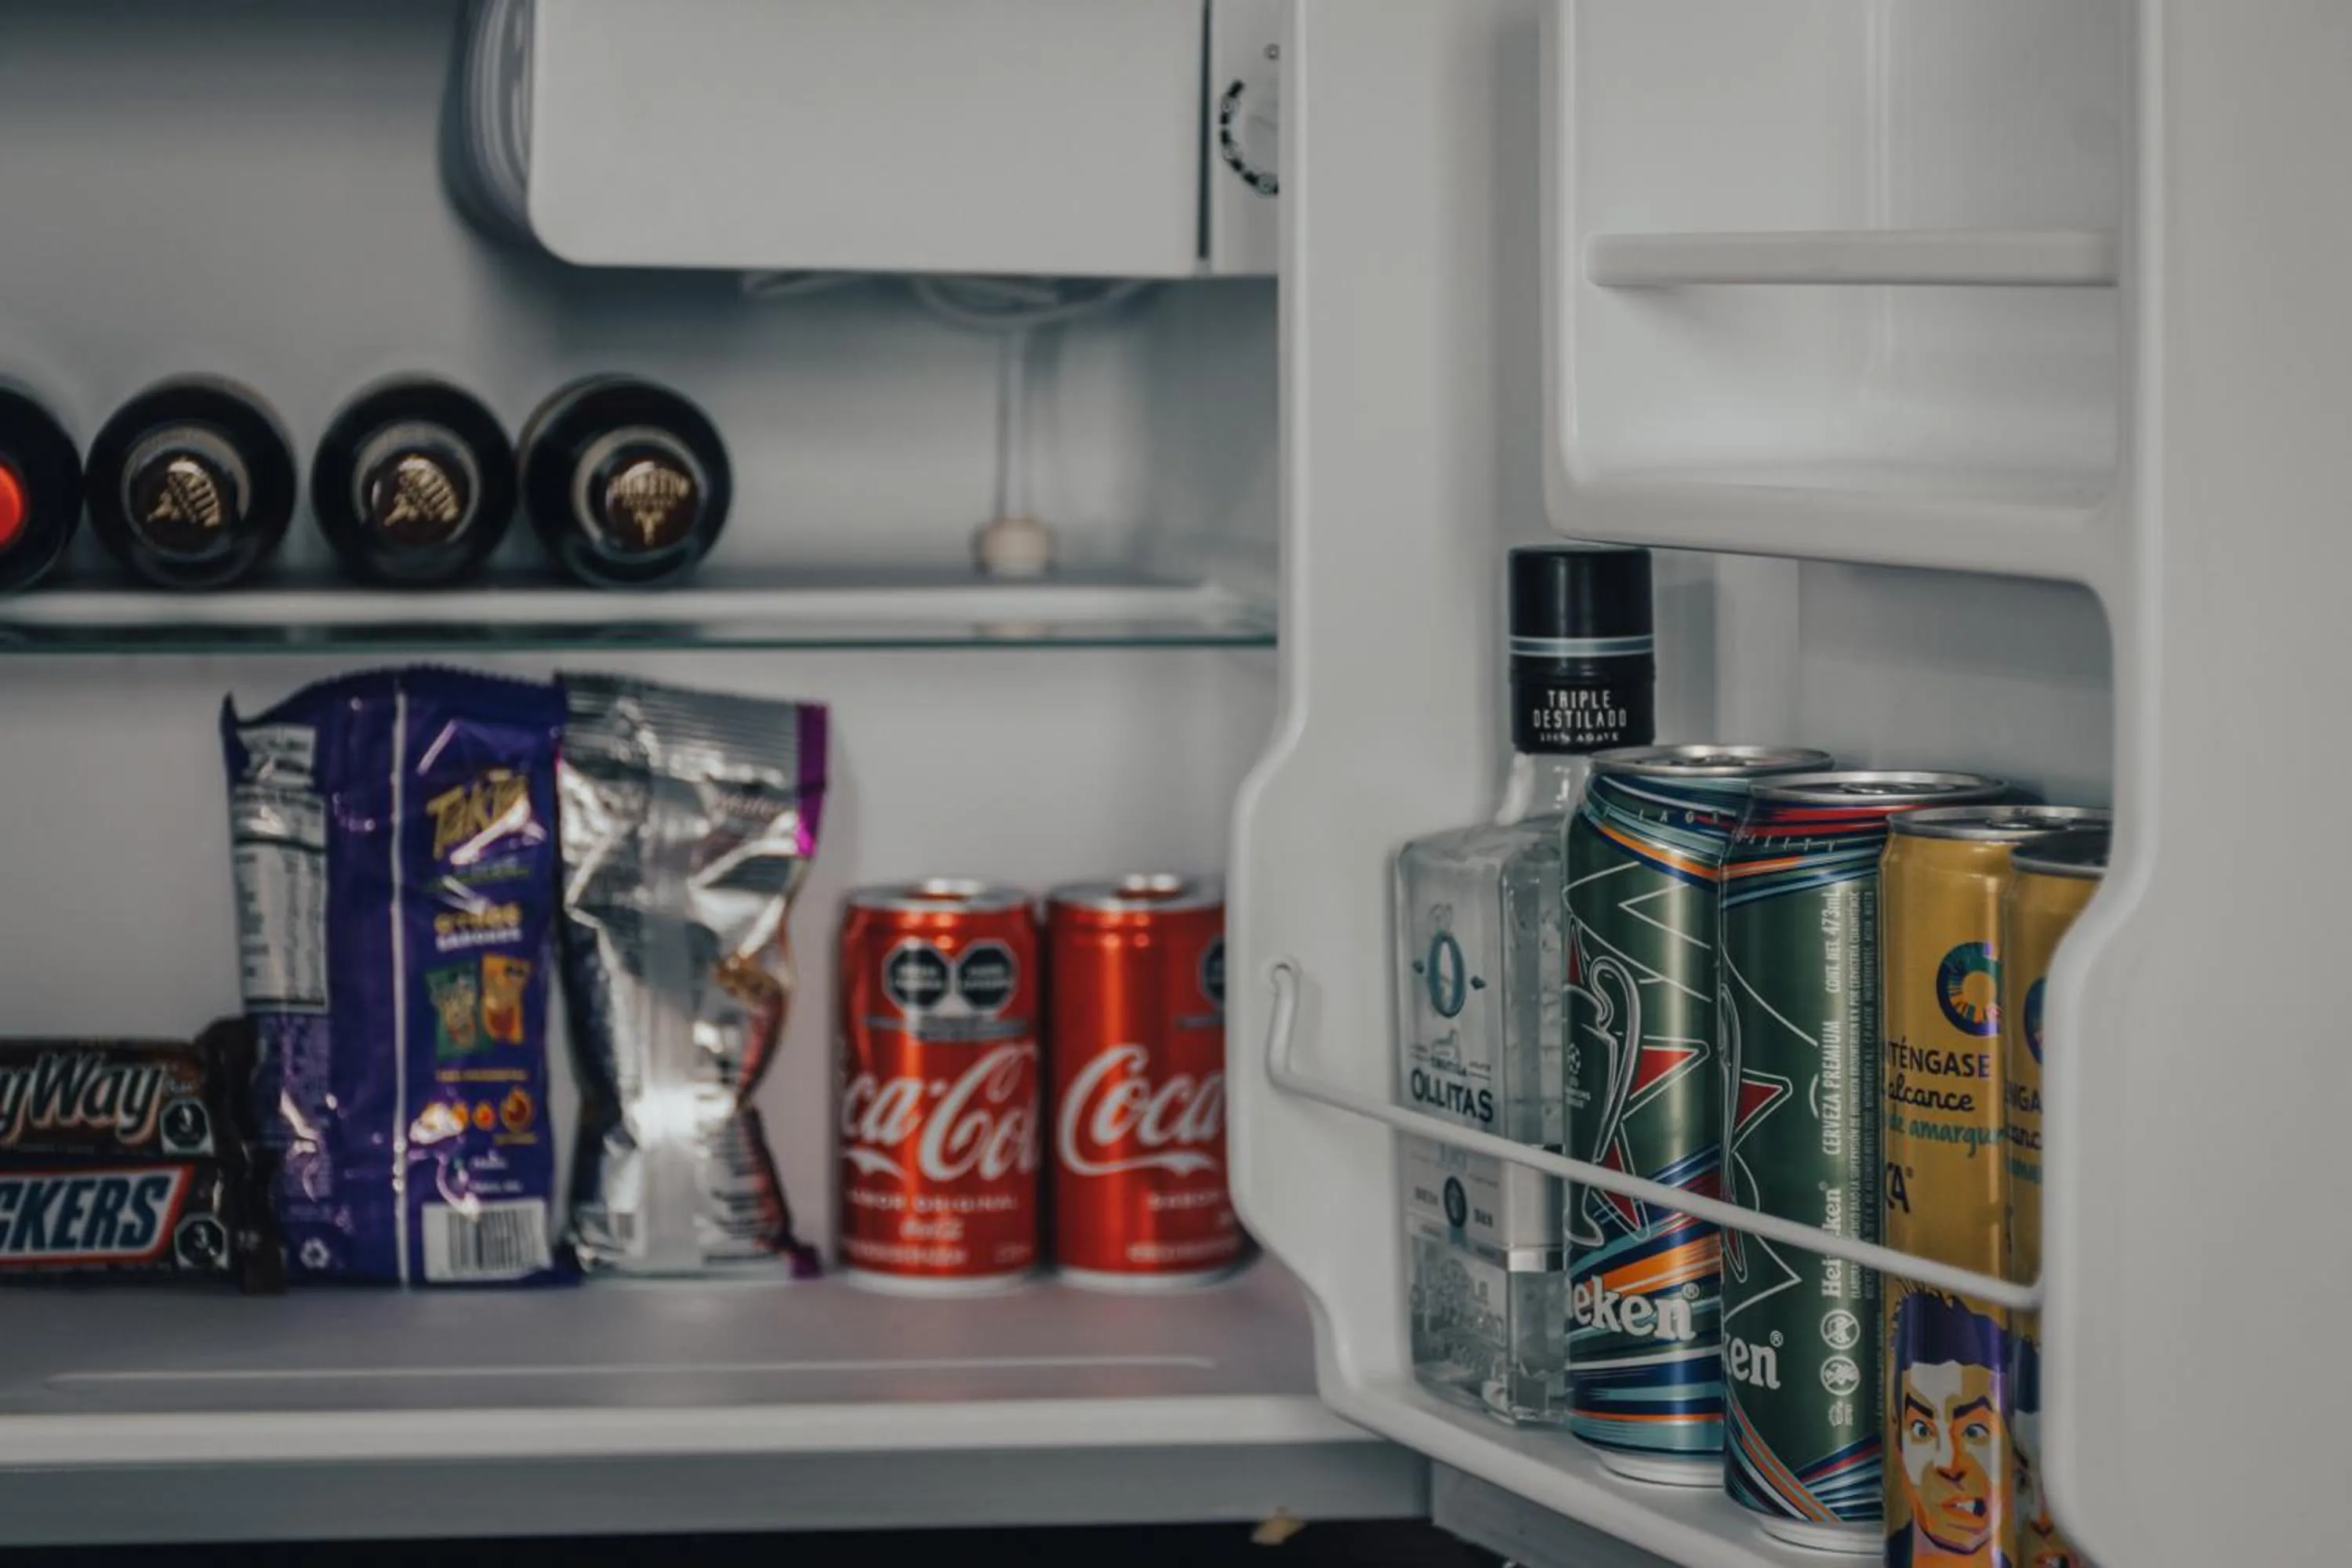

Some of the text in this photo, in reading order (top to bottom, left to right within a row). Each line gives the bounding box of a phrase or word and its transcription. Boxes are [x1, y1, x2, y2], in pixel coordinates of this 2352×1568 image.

[1534, 709, 1627, 728] DESTILADO
[1547, 690, 1611, 709] TRIPLE
[1886, 1036, 1992, 1078] TÉNGASE
[1410, 1068, 1494, 1123] OLLITAS
[1822, 1021, 1841, 1155] CERVEZA PREMIUM
[1822, 1189, 1842, 1298] Heiken
